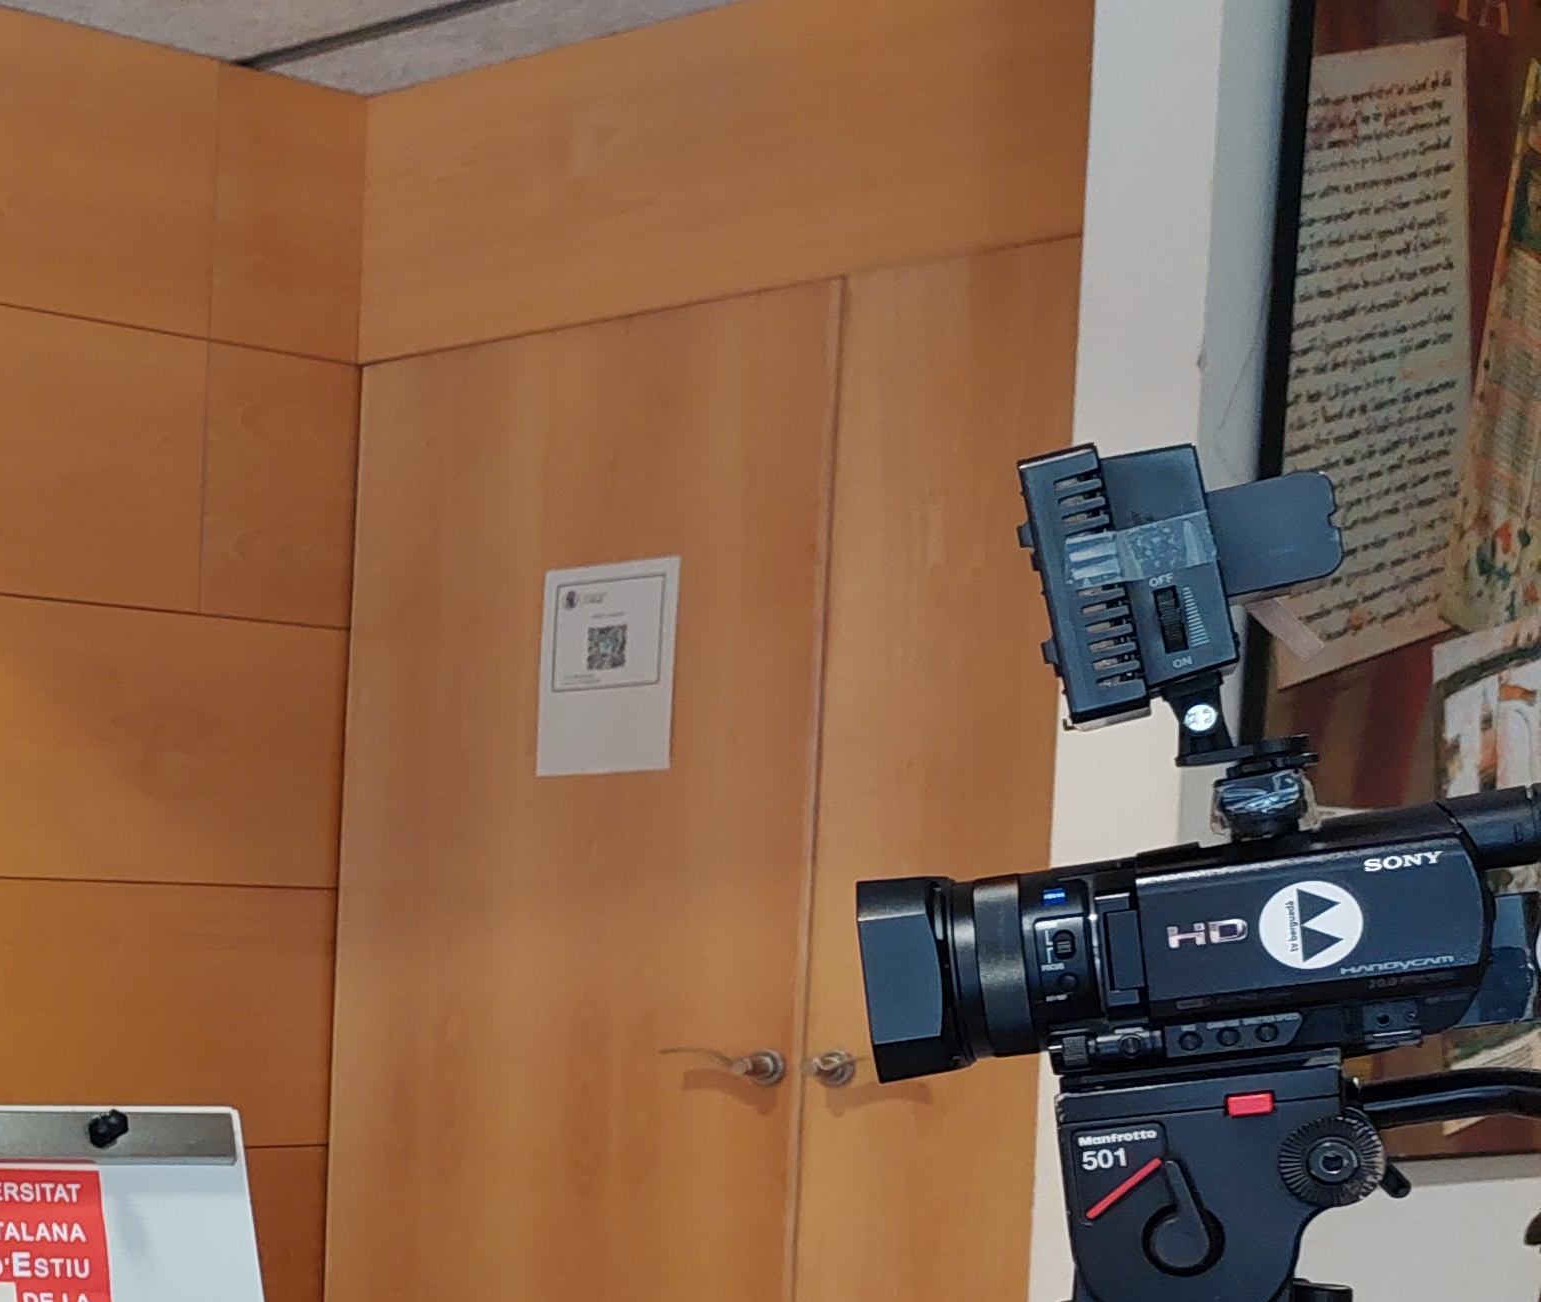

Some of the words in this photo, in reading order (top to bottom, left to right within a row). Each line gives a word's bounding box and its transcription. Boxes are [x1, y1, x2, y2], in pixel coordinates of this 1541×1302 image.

[1149, 572, 1174, 588] OFF
[1172, 656, 1193, 669] ON
[1363, 851, 1444, 872] SONY
[1166, 918, 1248, 949] HD
[1077, 1130, 1157, 1147] Manfrotto
[1082, 1147, 1127, 1171] 501
